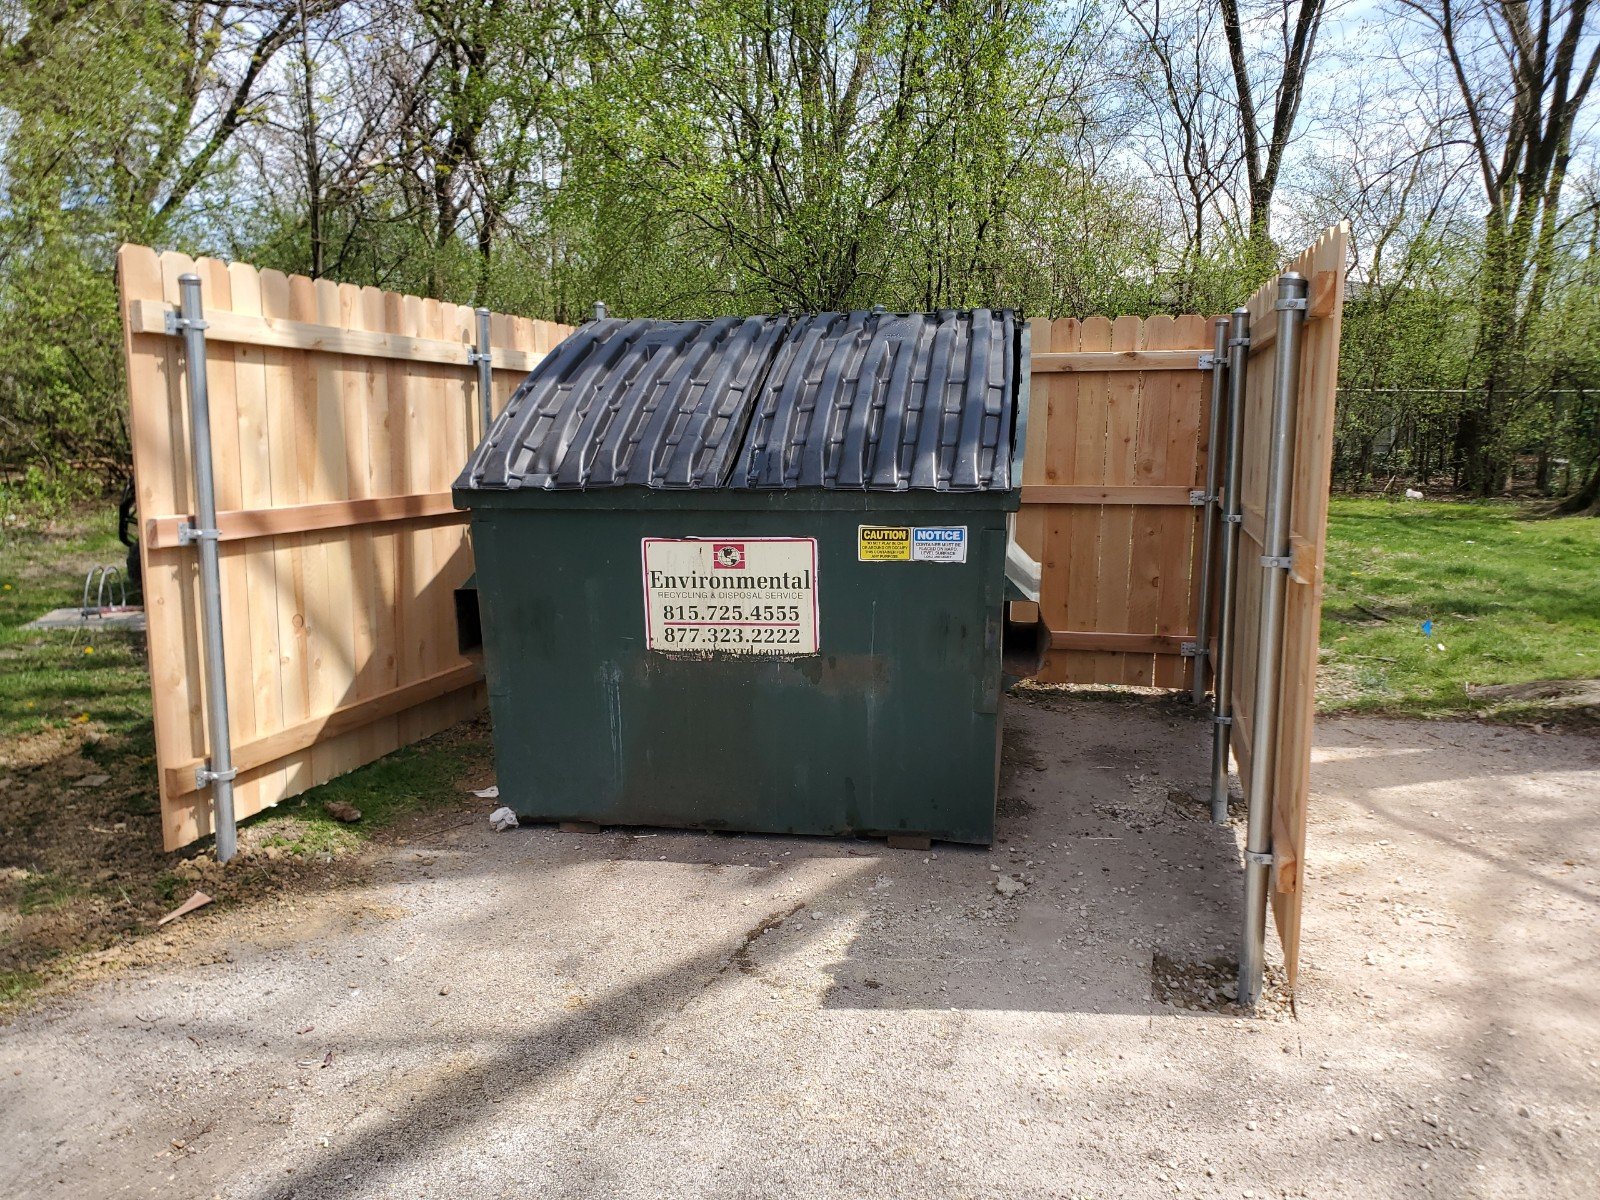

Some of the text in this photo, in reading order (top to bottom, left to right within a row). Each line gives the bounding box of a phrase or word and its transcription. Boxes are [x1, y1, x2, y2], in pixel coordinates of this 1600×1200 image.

[863, 530, 906, 540] CAUTION
[917, 530, 961, 540] NOTICE
[650, 570, 811, 590] Environmental
[658, 591, 708, 599] RECYCLING
[718, 592, 763, 600] DISPOSAL
[765, 592, 804, 600] SERVICE
[663, 605, 800, 621] 815.725.4555
[664, 627, 801, 644] 877.323.2222
